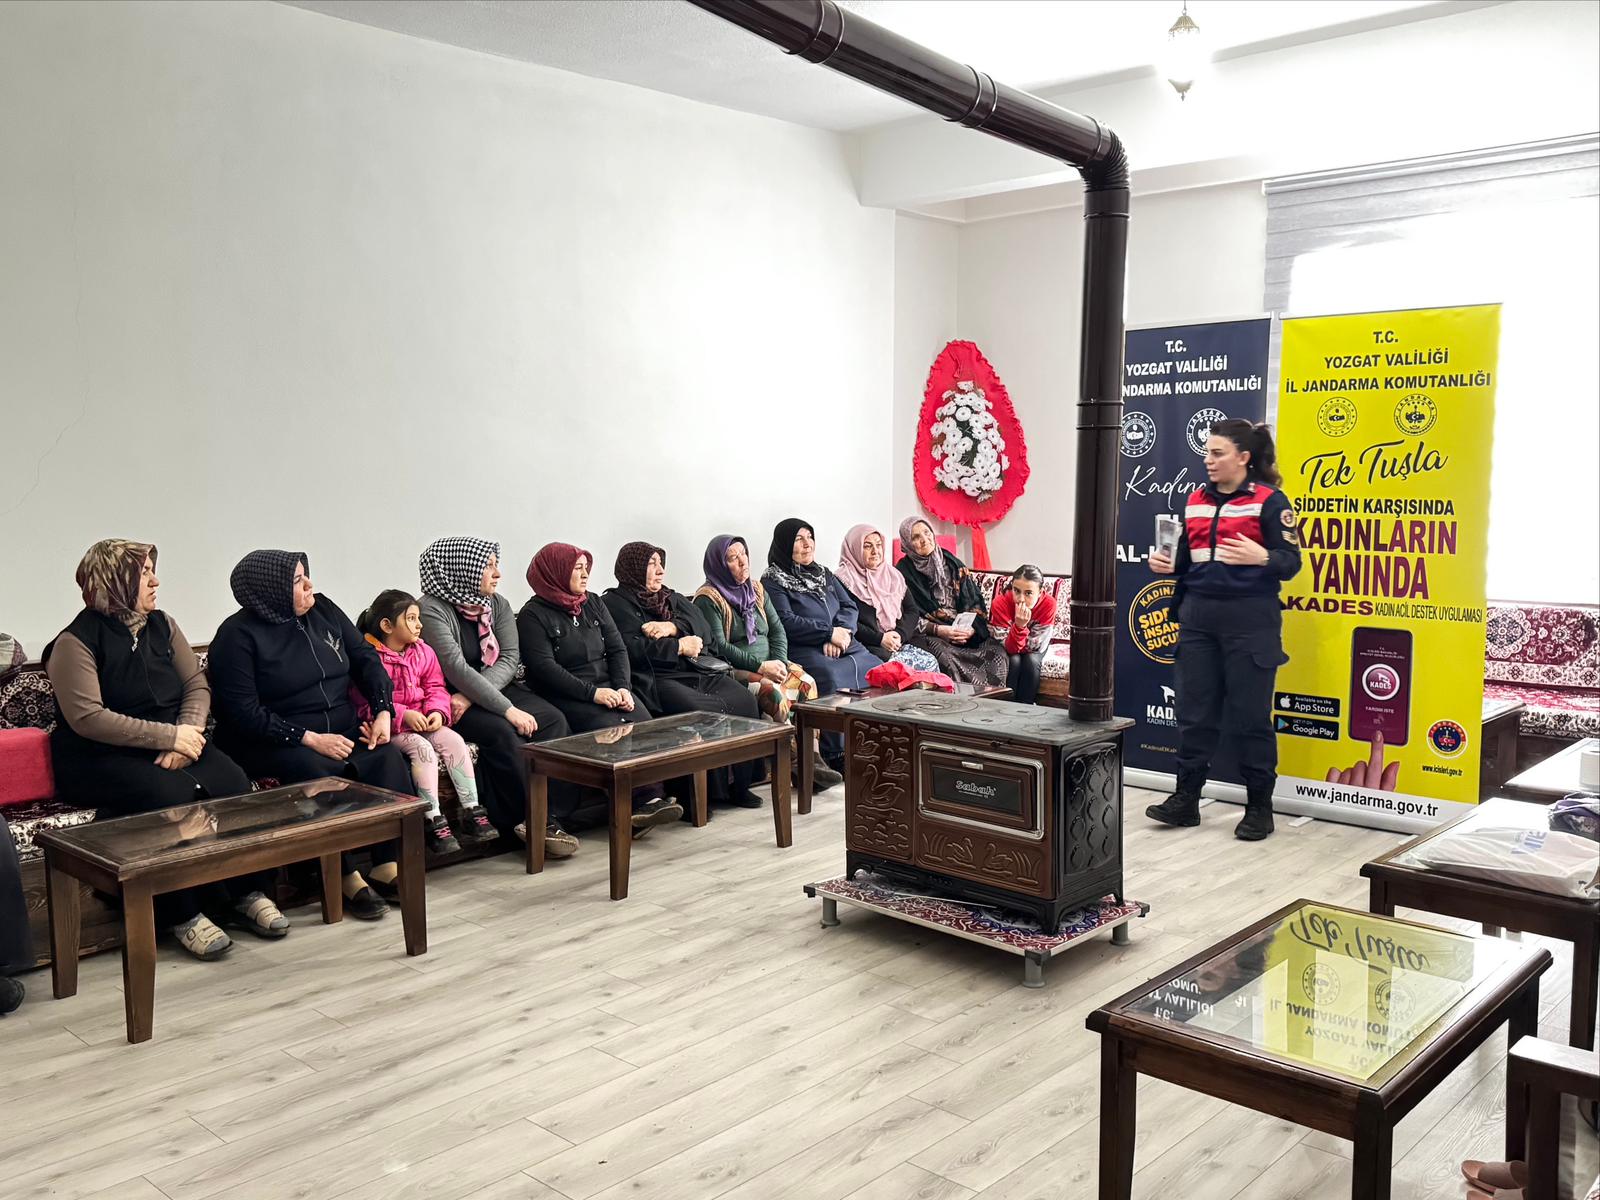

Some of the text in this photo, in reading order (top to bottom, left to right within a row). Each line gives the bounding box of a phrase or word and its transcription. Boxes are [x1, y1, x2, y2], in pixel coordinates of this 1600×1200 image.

[1165, 340, 1187, 353] T.C.
[1373, 330, 1399, 344] T.C.
[1126, 355, 1228, 376] YOZGAT VALİLİĞİ
[1324, 348, 1449, 369] YOZGAT VALİLİĞİ
[1175, 375, 1262, 395] KOMUTANLIĞI
[1286, 370, 1491, 393] İL JANDARMA KOMUTANLIĞI
[1301, 439, 1449, 493] Tek Tuşla
[1293, 493, 1455, 518] ŞİDDETİN KARŞISINDA
[1296, 517, 1458, 555] KADINLARIN
[1309, 553, 1430, 600] YANINDA
[1286, 596, 1374, 616] KADES
[1375, 602, 1395, 617] KADIN
[1411, 606, 1438, 620] DESTEK
[1439, 607, 1483, 623] UYGULAMASI
[1146, 631, 1180, 651] SUÇU
[1146, 704, 1177, 721] KAD
[1294, 702, 1335, 714] App Store
[1292, 724, 1335, 738] Google Play
[955, 780, 995, 796] Sabah
[1296, 784, 1439, 817] www.jandarma.gov.tr
